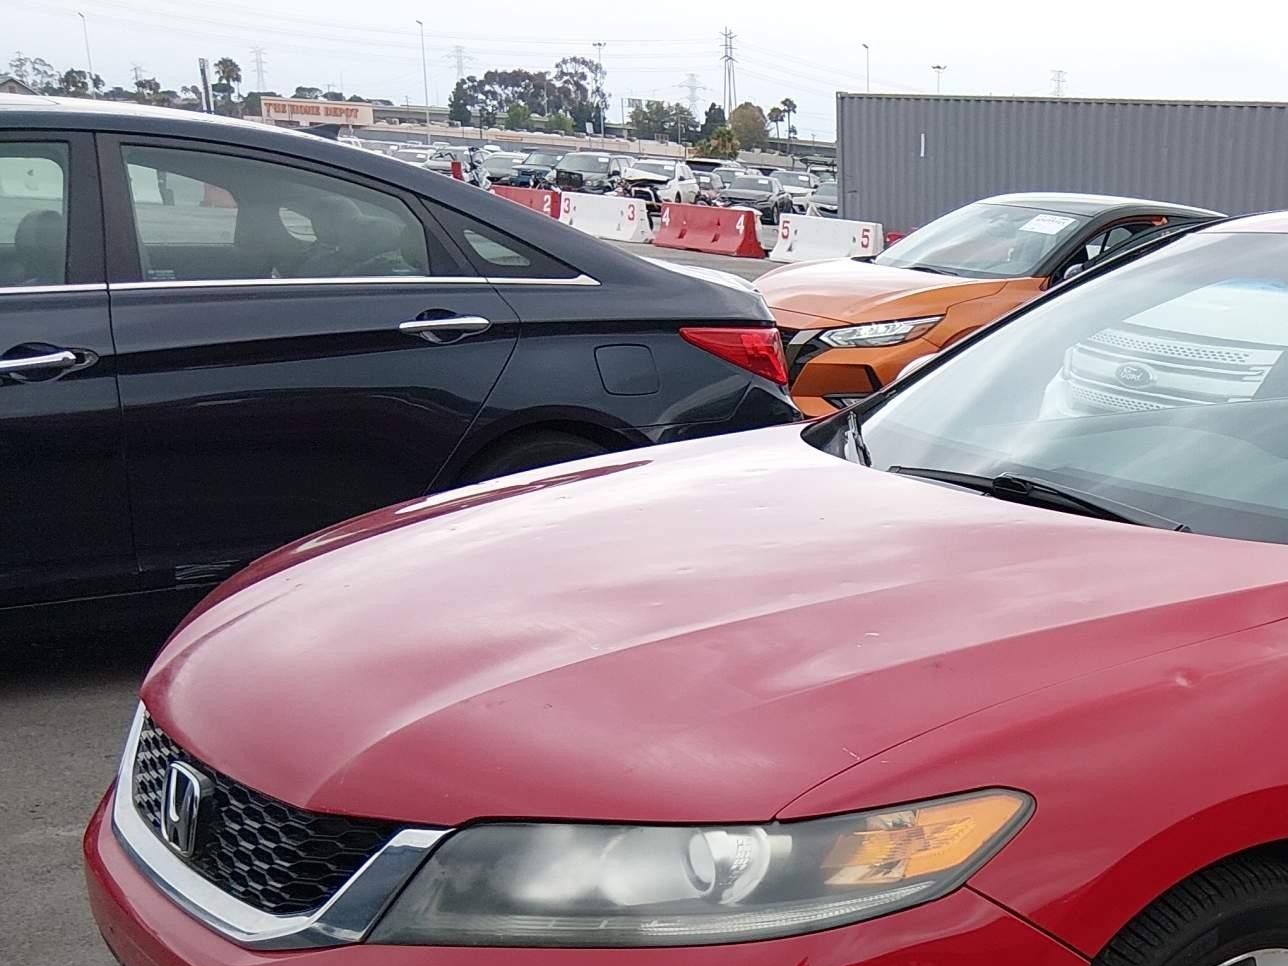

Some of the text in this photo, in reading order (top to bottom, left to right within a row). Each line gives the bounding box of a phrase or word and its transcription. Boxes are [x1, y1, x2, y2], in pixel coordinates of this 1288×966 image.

[543, 194, 552, 213] 2
[563, 197, 571, 214] 3
[627, 204, 636, 221] 3
[661, 207, 670, 226] 4
[735, 214, 744, 234] 4
[781, 220, 790, 240] 5
[861, 228, 871, 249] 5
